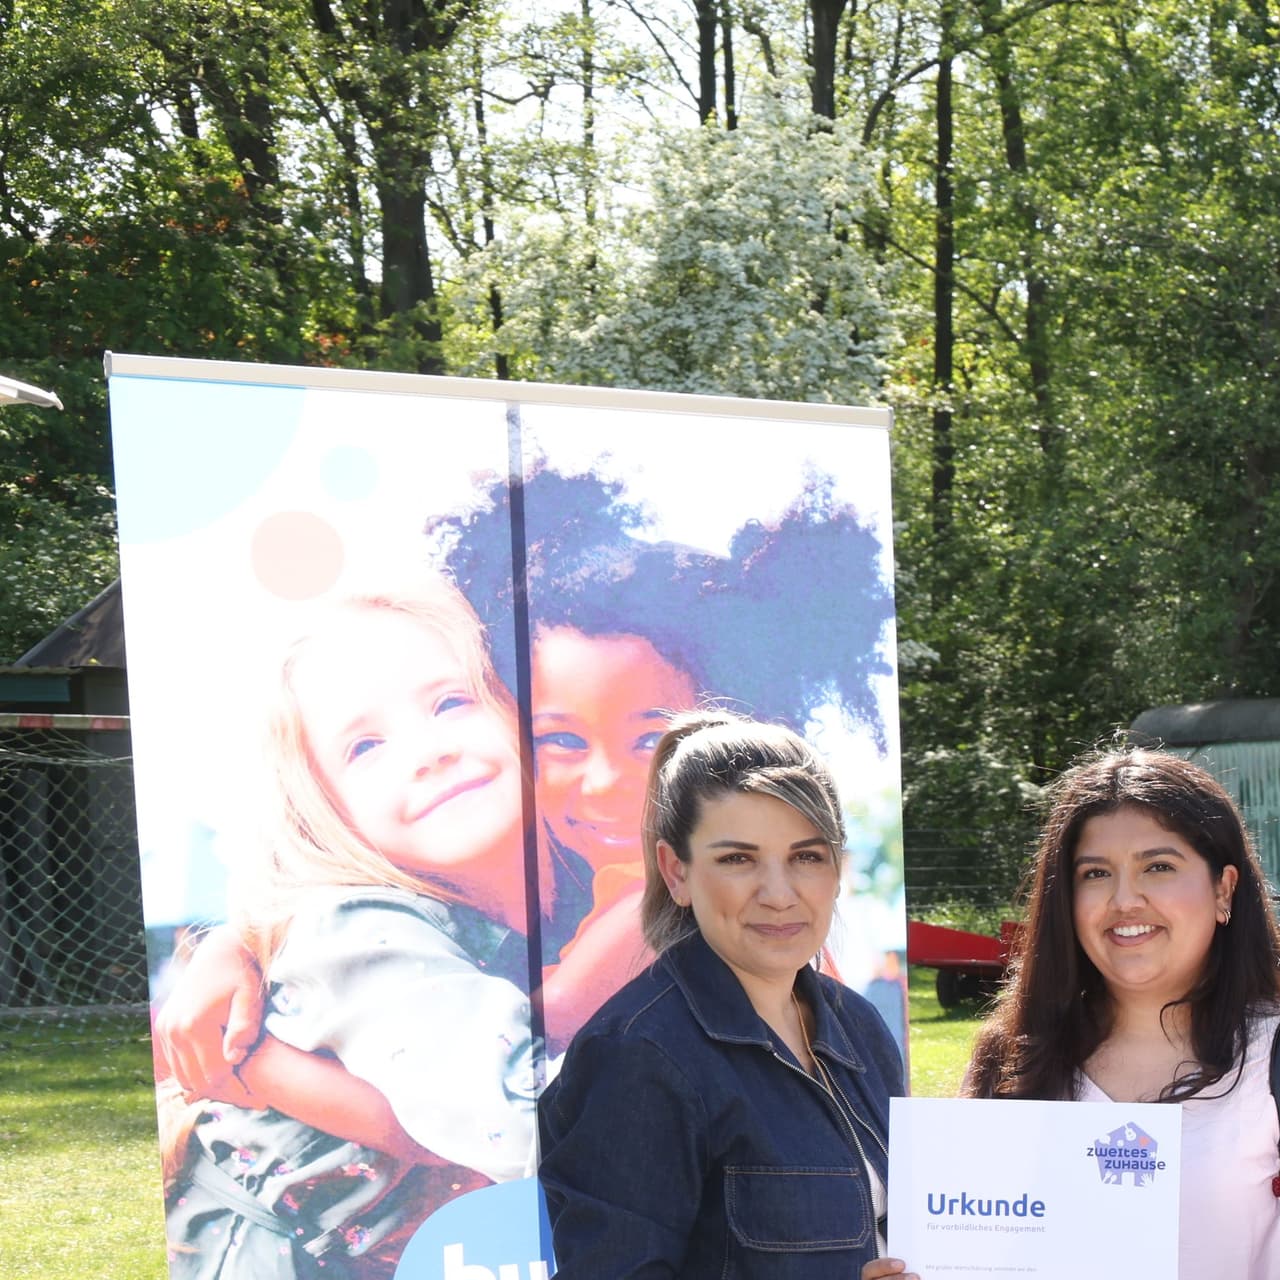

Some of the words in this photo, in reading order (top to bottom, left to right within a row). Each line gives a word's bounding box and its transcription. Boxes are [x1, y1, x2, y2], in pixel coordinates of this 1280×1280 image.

[927, 1192, 1046, 1217] Urkunde
[926, 1222, 941, 1231] für
[941, 1223, 993, 1232] vorbildliches
[994, 1224, 1046, 1234] Engagement
